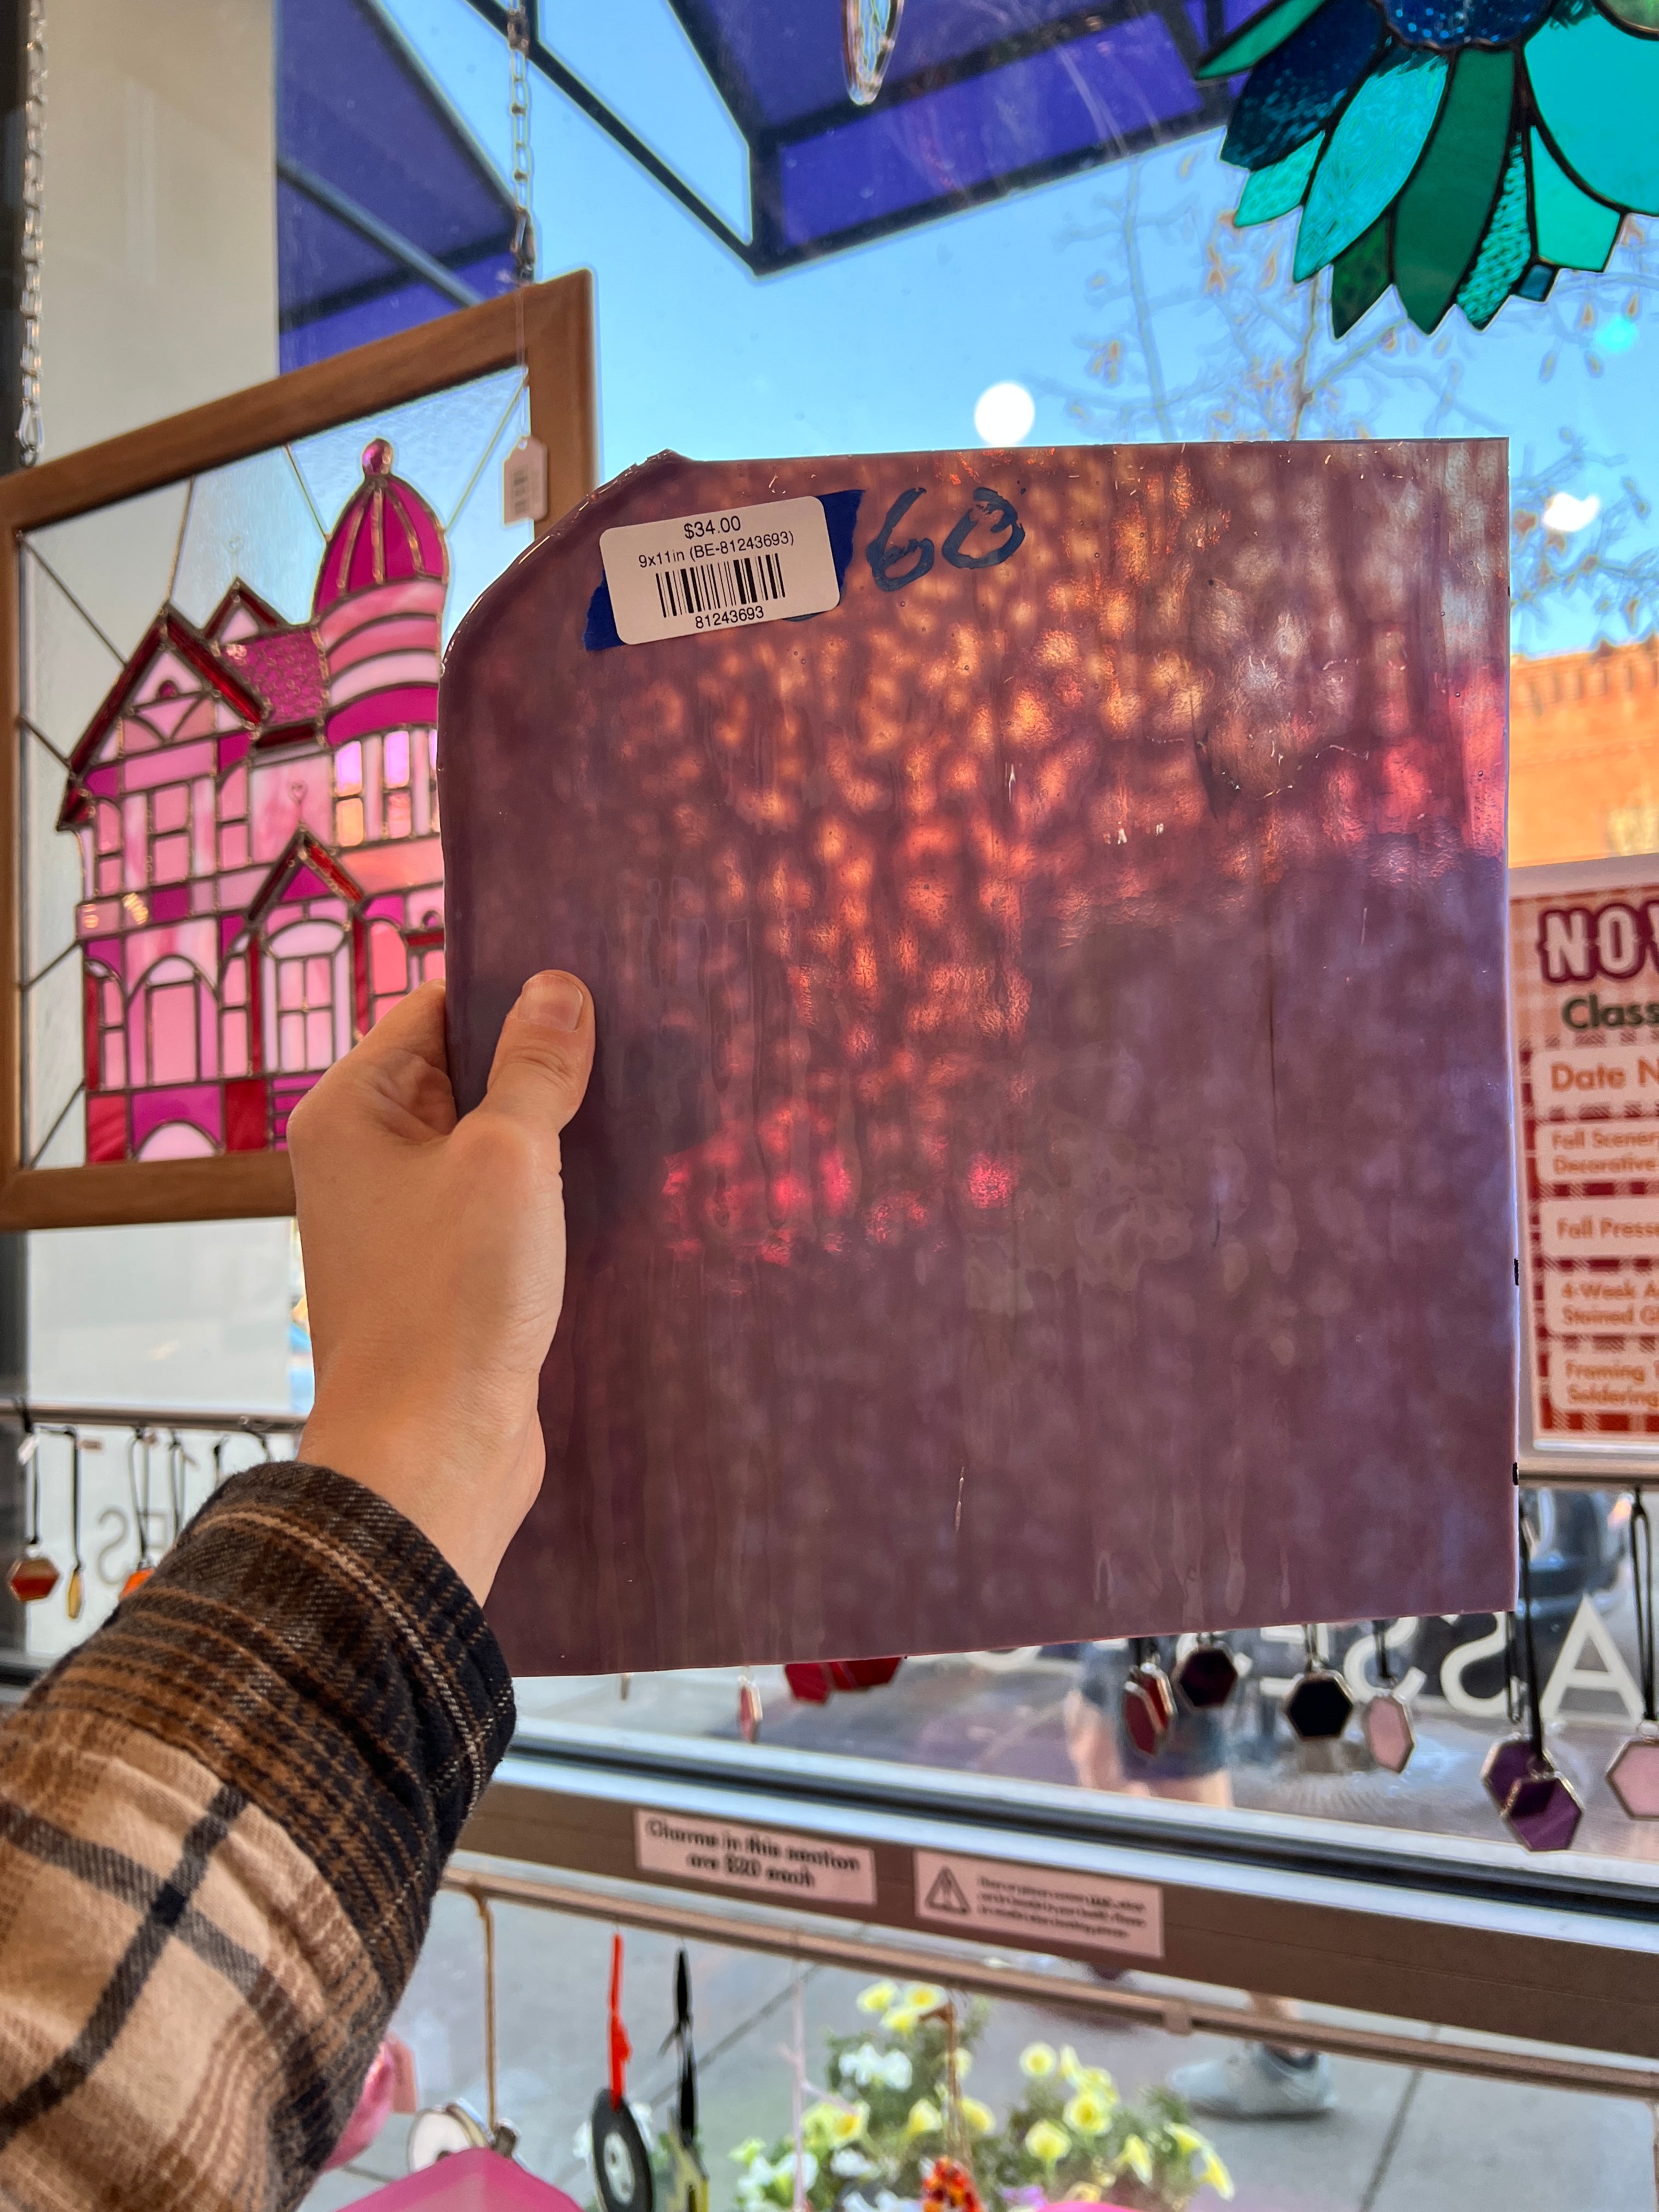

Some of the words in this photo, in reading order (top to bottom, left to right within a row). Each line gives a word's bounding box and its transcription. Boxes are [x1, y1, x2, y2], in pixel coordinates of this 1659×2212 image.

[684, 515, 741, 540] $34.00
[638, 549, 685, 568] 9x11in
[690, 531, 794, 562] (BE-81243693)
[695, 605, 764, 629] 81243693
[1550, 1062, 1626, 1091] Date
